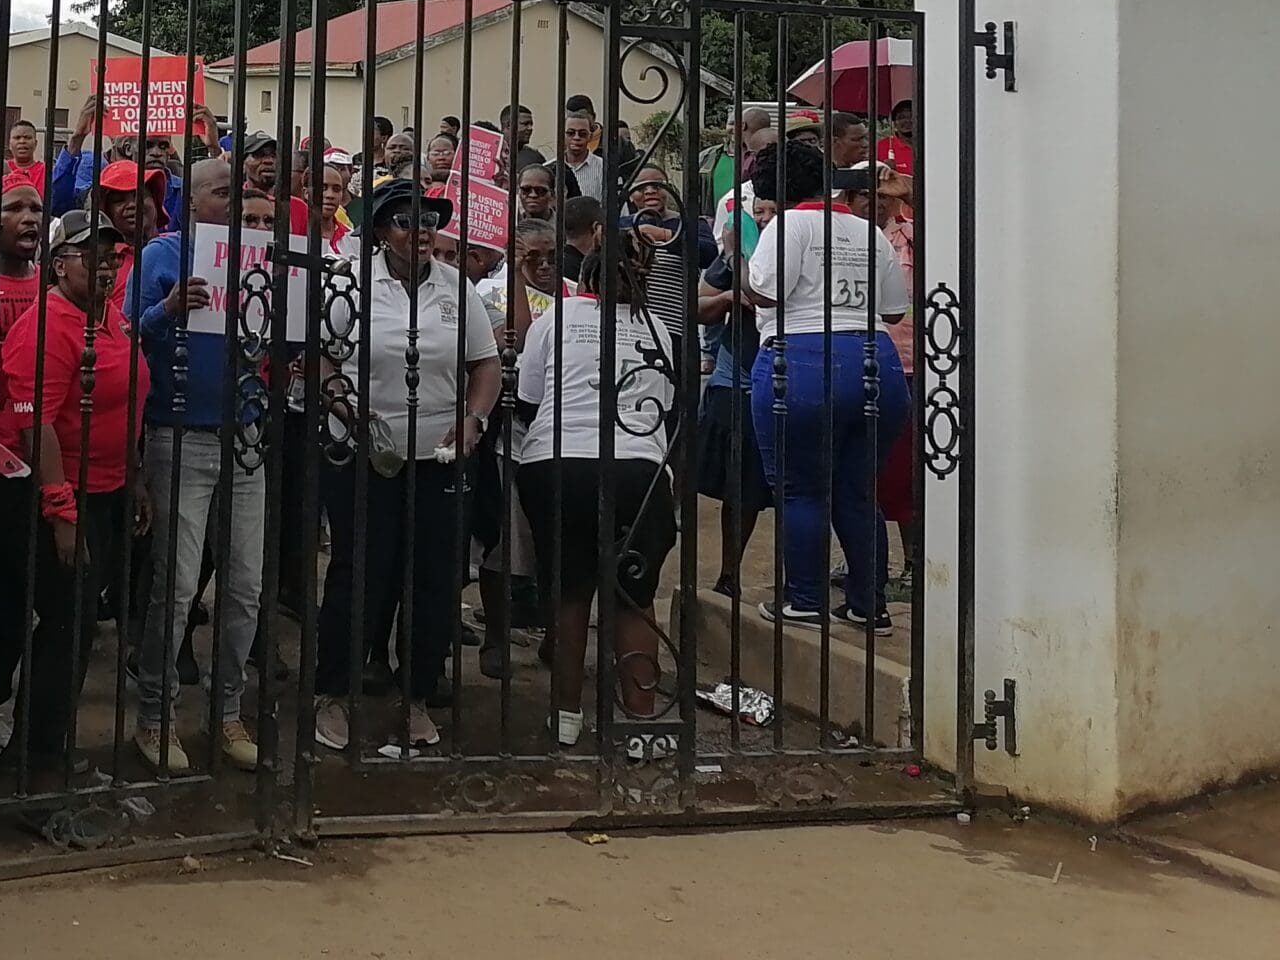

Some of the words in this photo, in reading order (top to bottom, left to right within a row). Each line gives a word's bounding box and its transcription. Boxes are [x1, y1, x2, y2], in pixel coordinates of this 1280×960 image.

[103, 80, 190, 95] IMPLMENT
[101, 93, 195, 108] RESOUTIO
[111, 108, 121, 121] 1
[148, 106, 186, 120] 2018
[456, 196, 490, 214] CURTS
[491, 206, 503, 218] TO
[478, 194, 504, 211] USING
[451, 210, 504, 236] BAGAINING
[461, 208, 494, 224] ETTLE
[831, 278, 868, 310] 35
